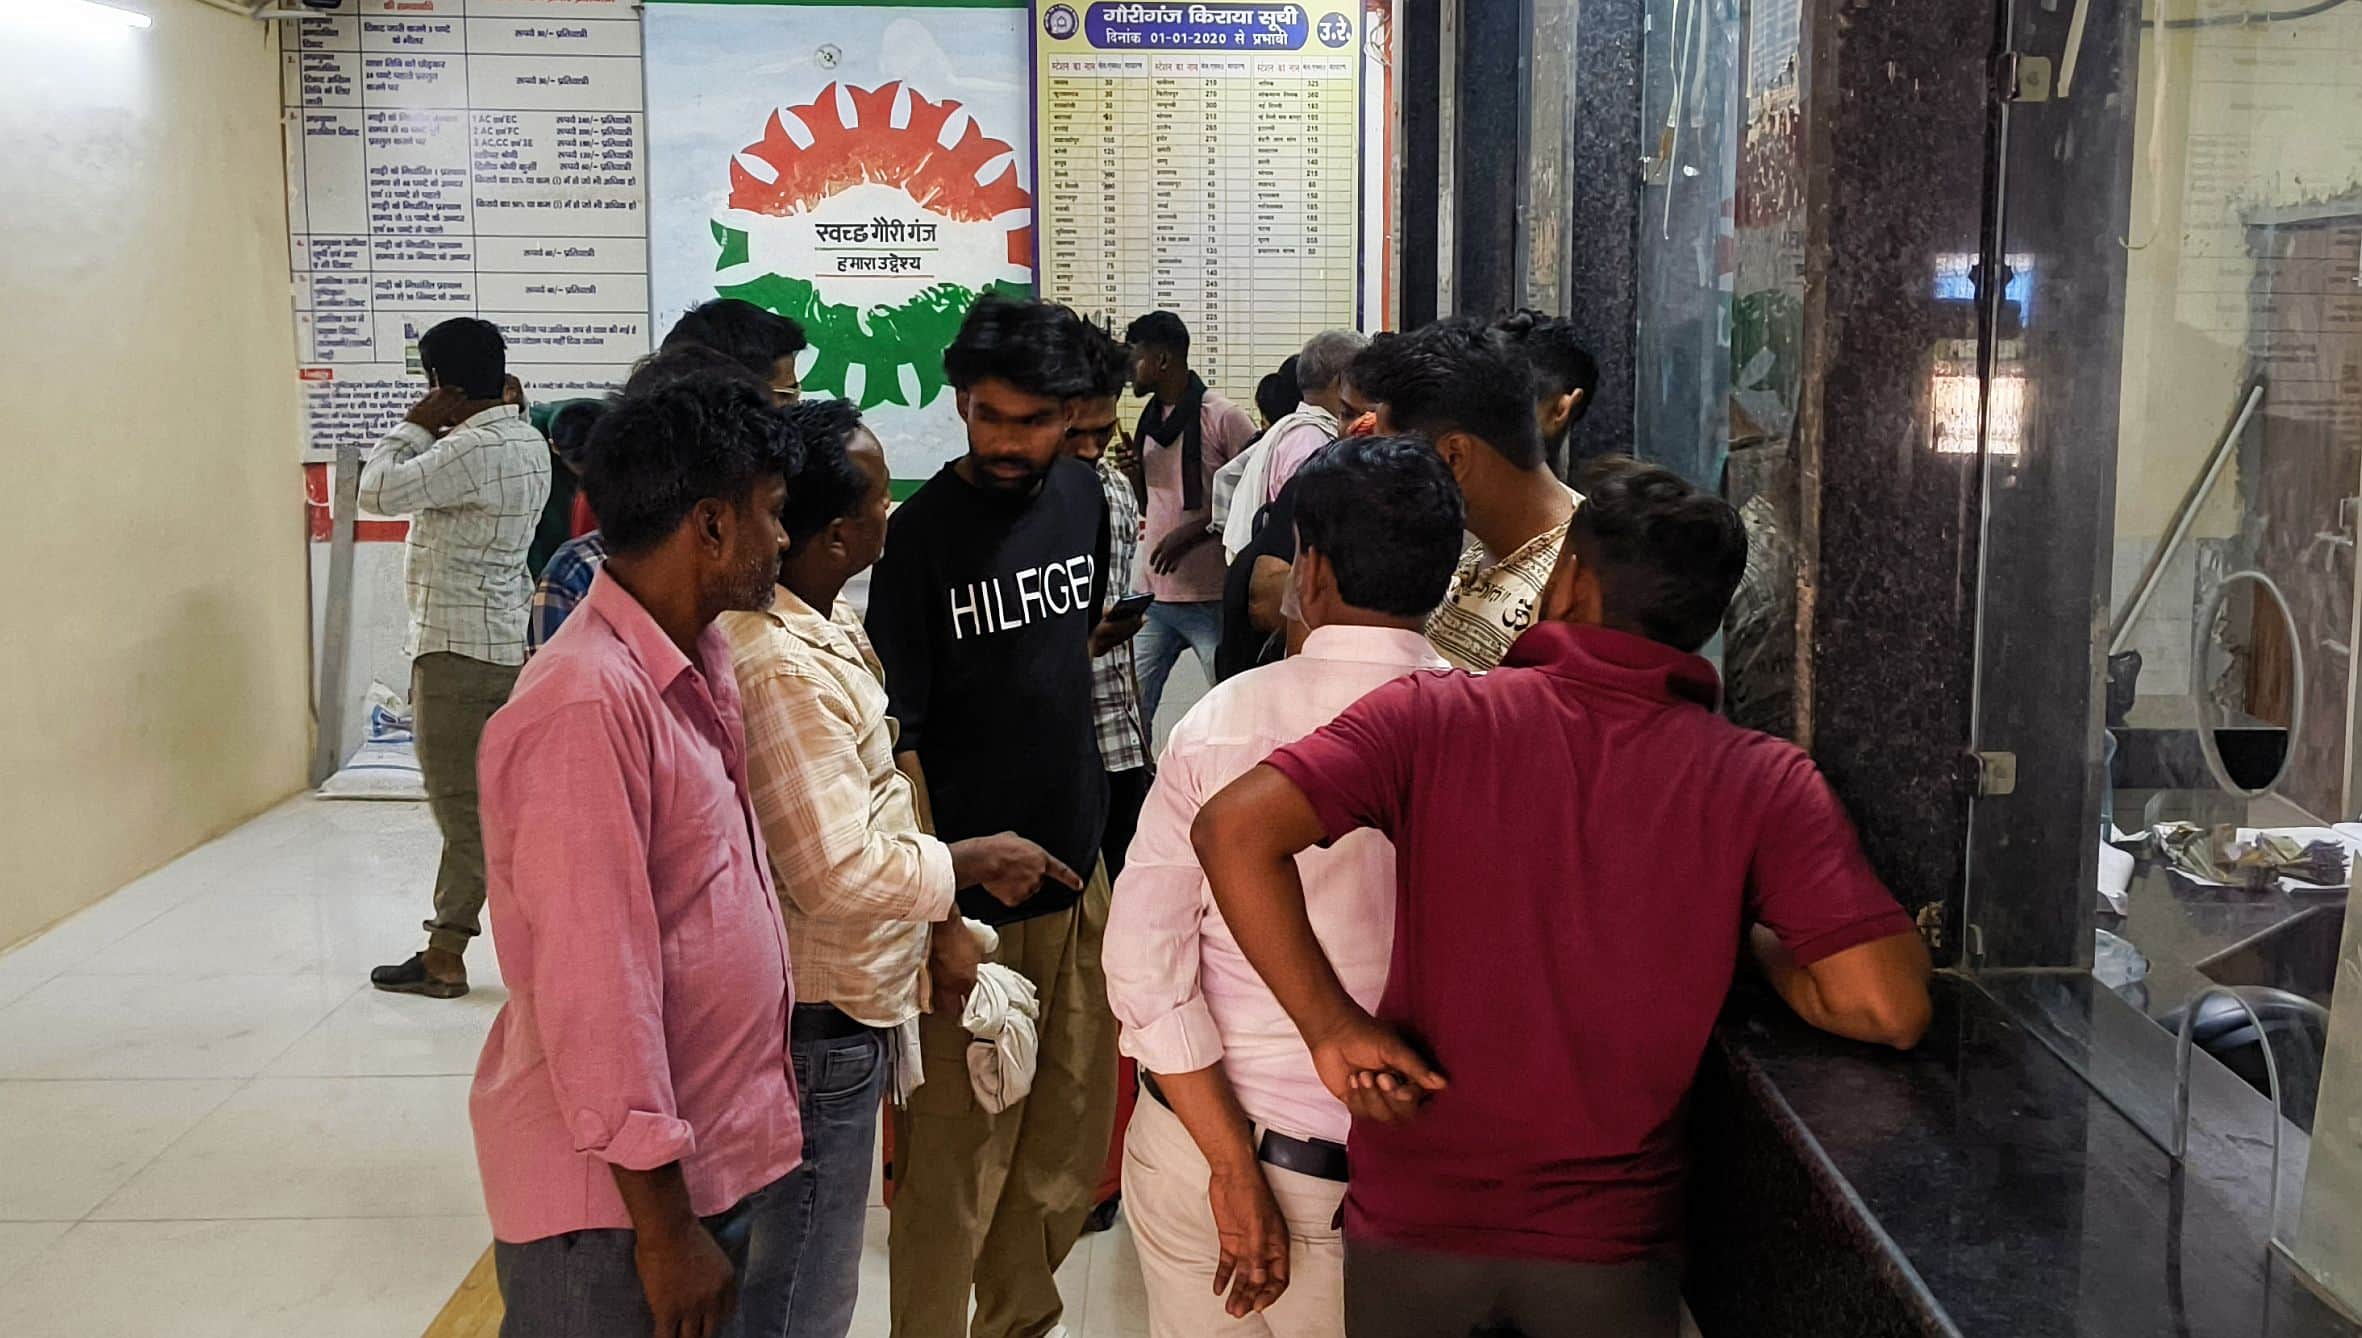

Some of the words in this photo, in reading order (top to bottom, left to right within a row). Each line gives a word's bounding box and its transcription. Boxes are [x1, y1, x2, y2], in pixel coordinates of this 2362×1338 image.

[1102, 4, 1182, 24] गौरीगंज
[1188, 5, 1253, 25] किराया
[1258, 6, 1299, 31] सूची
[1106, 28, 1141, 44] दिनांक
[1150, 33, 1227, 44] 01-01-2020
[1234, 29, 1245, 45] से
[815, 223, 869, 243] स्वच्छ
[837, 256, 876, 272] हमारा
[878, 252, 921, 273] उद्देश्य
